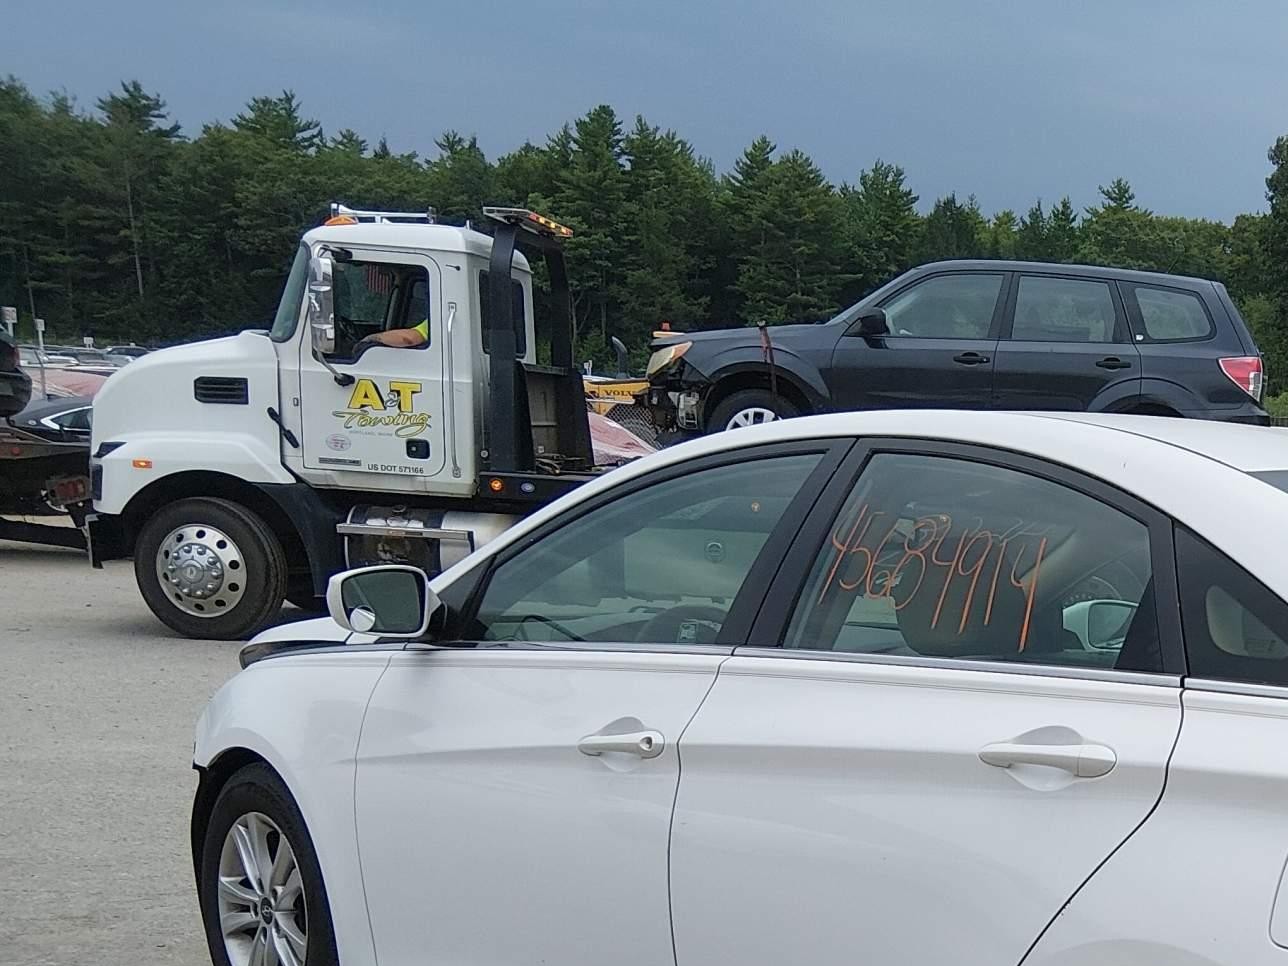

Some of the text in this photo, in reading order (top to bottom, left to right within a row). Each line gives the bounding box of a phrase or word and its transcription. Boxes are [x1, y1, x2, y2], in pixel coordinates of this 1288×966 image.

[605, 389, 634, 397] VOLV
[332, 410, 432, 438] Towing
[367, 463, 379, 471] US
[380, 464, 397, 472] DOT
